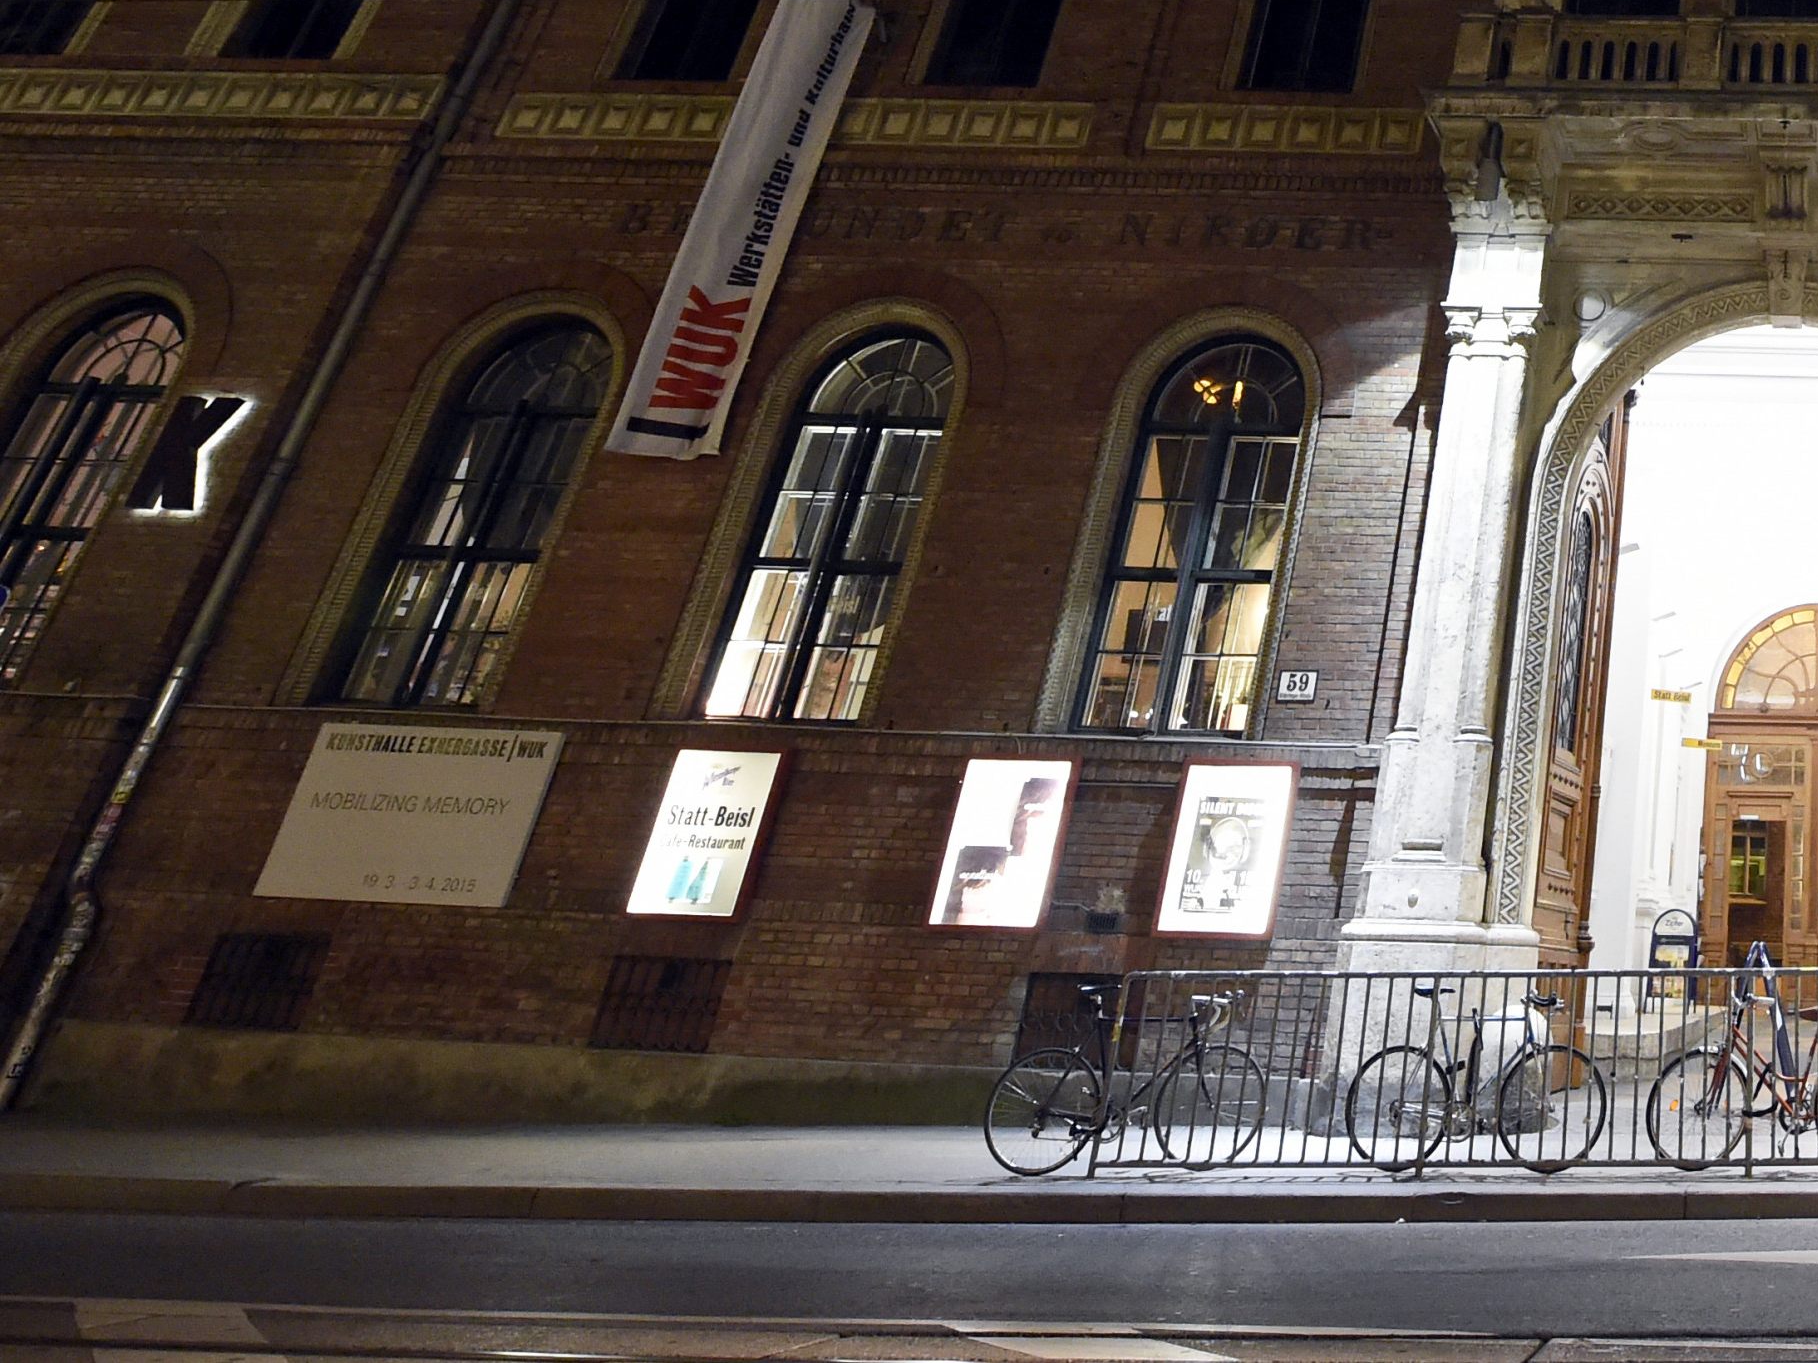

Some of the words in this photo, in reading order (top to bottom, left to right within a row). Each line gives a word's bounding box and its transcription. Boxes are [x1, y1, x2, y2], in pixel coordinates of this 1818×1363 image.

[648, 284, 751, 409] WUK
[727, 152, 795, 288] Werkstätten-
[788, 109, 811, 148] und
[125, 395, 248, 512] K
[1286, 672, 1310, 693] 59
[325, 732, 417, 754] KUNSTHALLE
[310, 792, 418, 813] MOBILIZING
[421, 796, 512, 816] MEMORY
[1200, 802, 1236, 815] SILENT
[667, 805, 756, 828] Statt-Beisl
